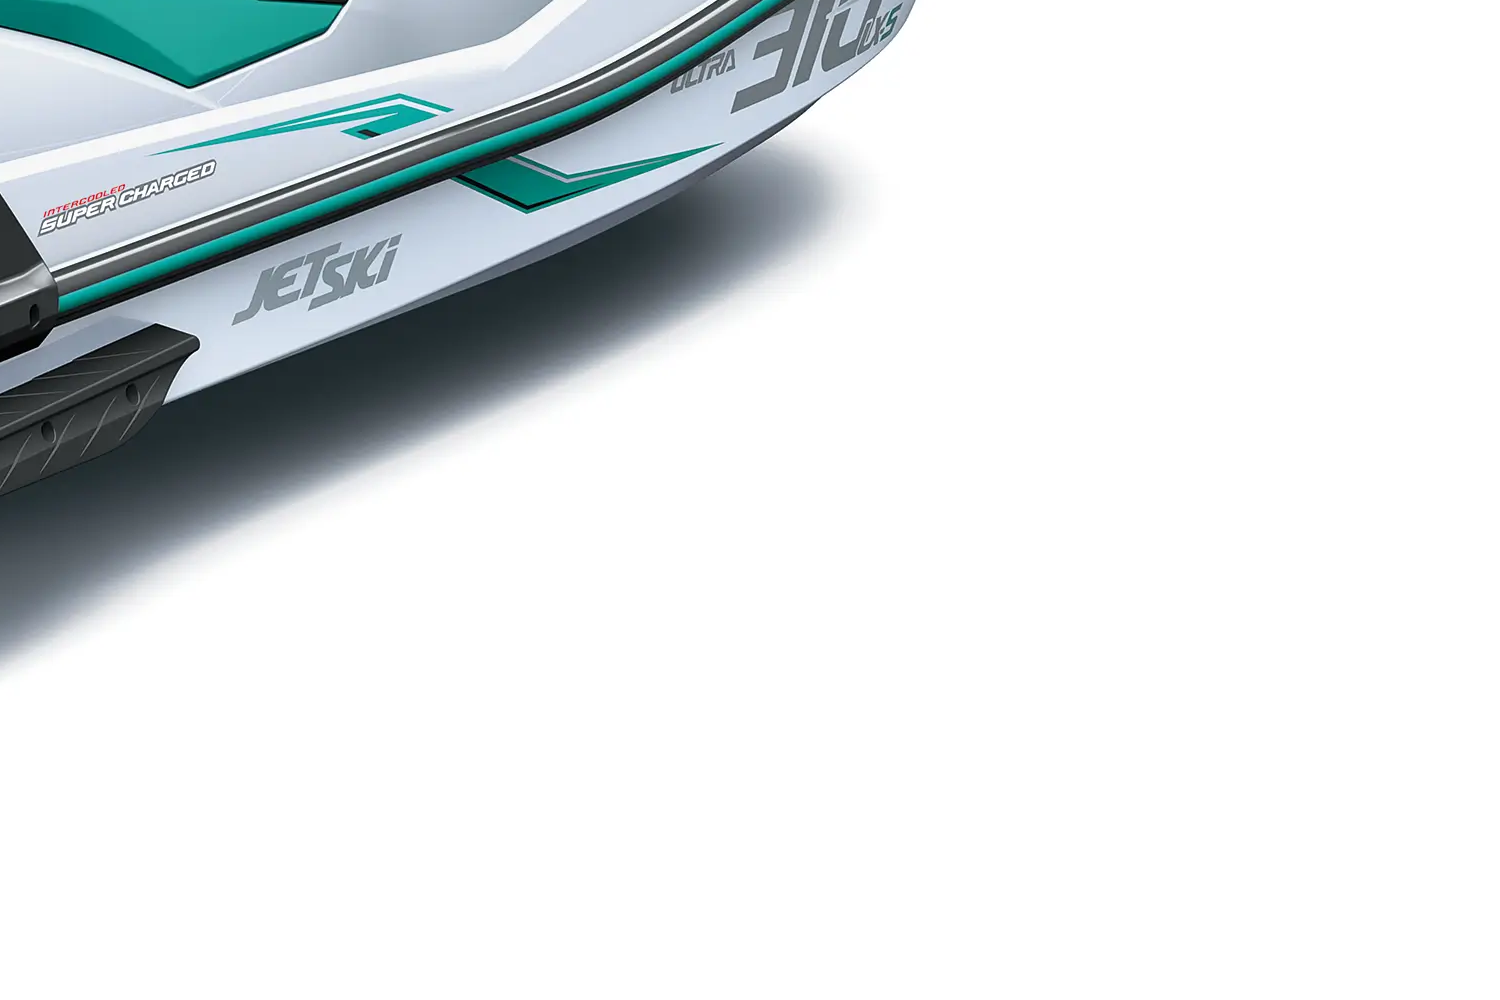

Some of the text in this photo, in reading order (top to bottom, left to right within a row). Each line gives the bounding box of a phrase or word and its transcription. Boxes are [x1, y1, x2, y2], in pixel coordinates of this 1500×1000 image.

[37, 159, 217, 237] SUPER CHARGED
[43, 183, 126, 218] INTERCOOLED
